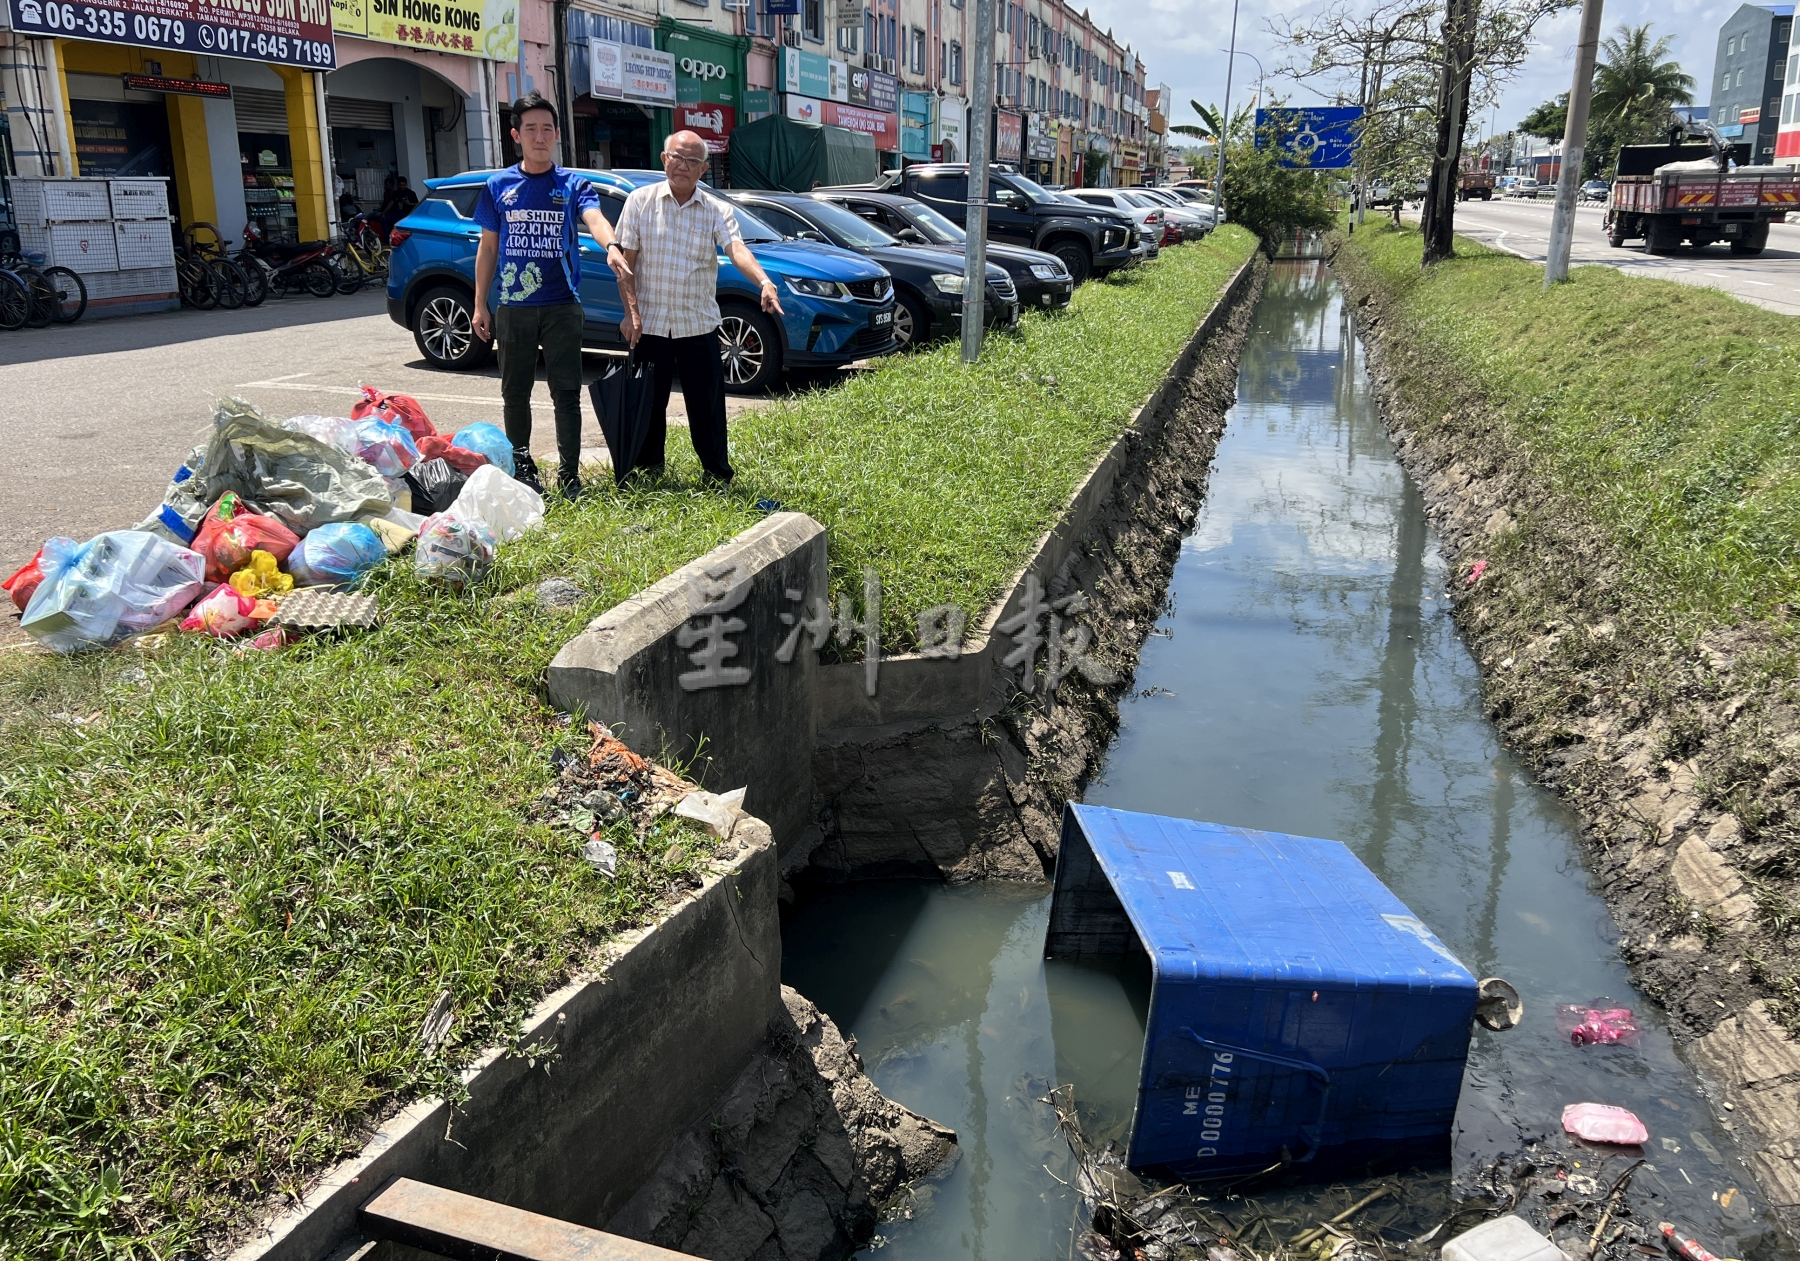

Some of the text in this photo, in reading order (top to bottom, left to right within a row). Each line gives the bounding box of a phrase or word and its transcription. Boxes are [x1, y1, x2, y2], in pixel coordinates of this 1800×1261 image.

[45, 1, 185, 44] 06-335 0679
[131, 2, 155, 13] JALAN
[156, 6, 184, 18] BERKAT
[196, 12, 219, 23] TAMAN
[219, 16, 240, 27] MALIM
[259, 23, 277, 33] 75250
[198, 6, 210, 14] NO.
[211, 7, 237, 18] PERMIT:
[373, 0, 480, 32] SIN HONG KONG
[217, 27, 332, 65] 017-645 7199
[624, 61, 672, 80] LEONG HIP MENG
[680, 57, 726, 81] oppo
[505, 209, 565, 223] LECSHINE
[527, 223, 541, 235] JCI
[531, 236, 563, 250] WASTE
[1182, 1085, 1201, 1115] ME
[1200, 1052, 1234, 1141] 0000776
